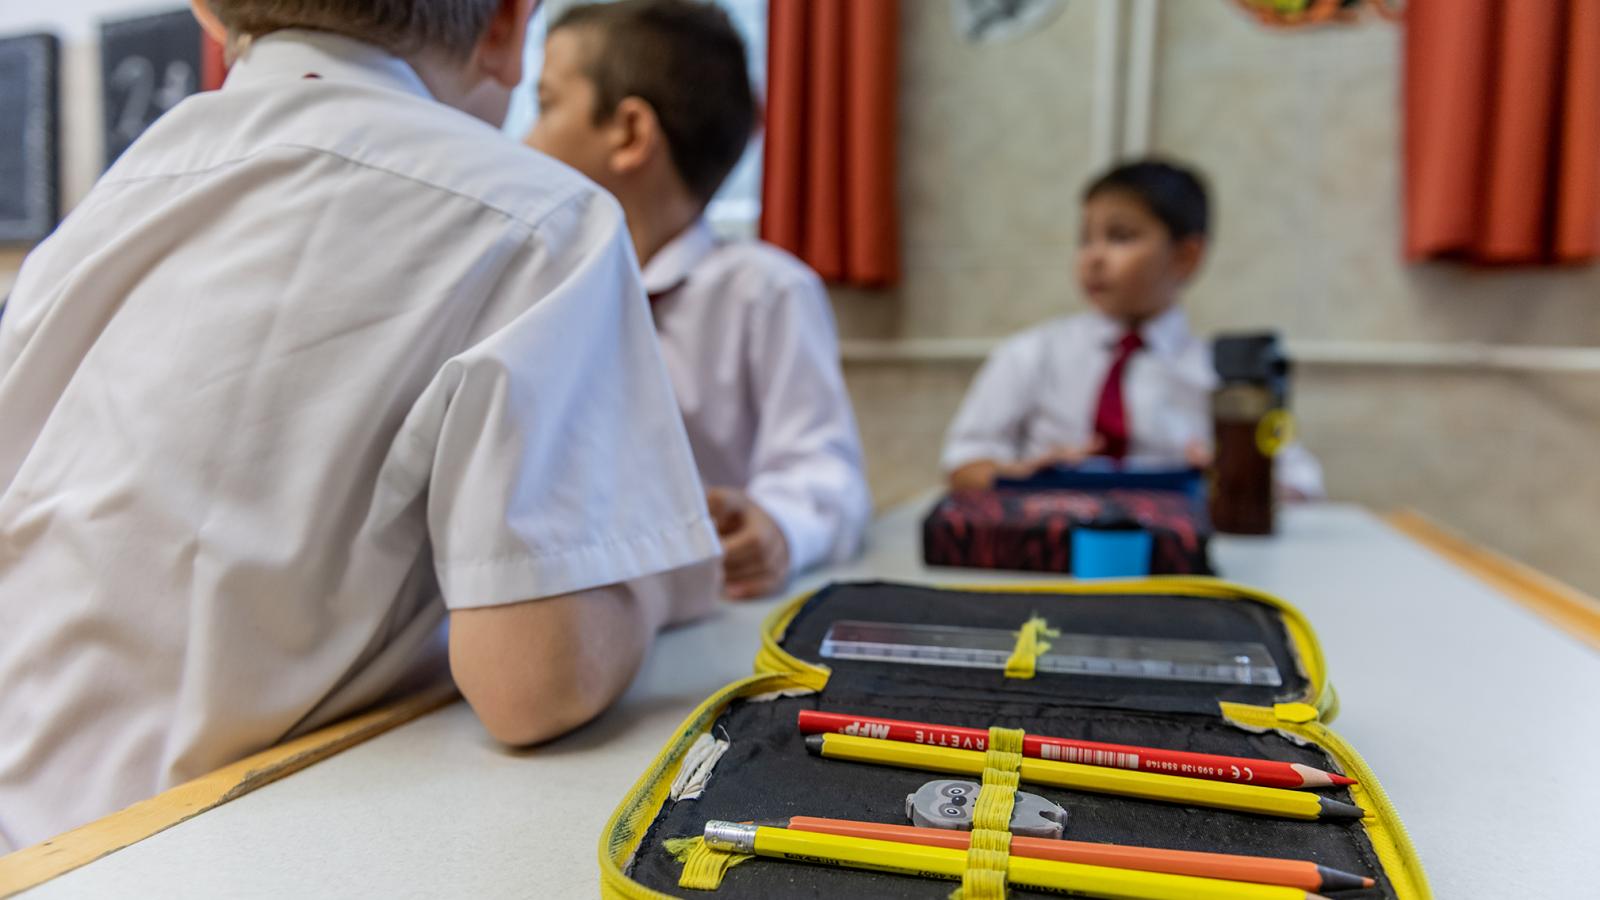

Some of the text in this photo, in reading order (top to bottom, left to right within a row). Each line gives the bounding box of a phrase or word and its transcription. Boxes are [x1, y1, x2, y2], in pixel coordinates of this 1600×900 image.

[845, 721, 985, 750] RVETTE MFP
[1217, 768, 1224, 776] 8
